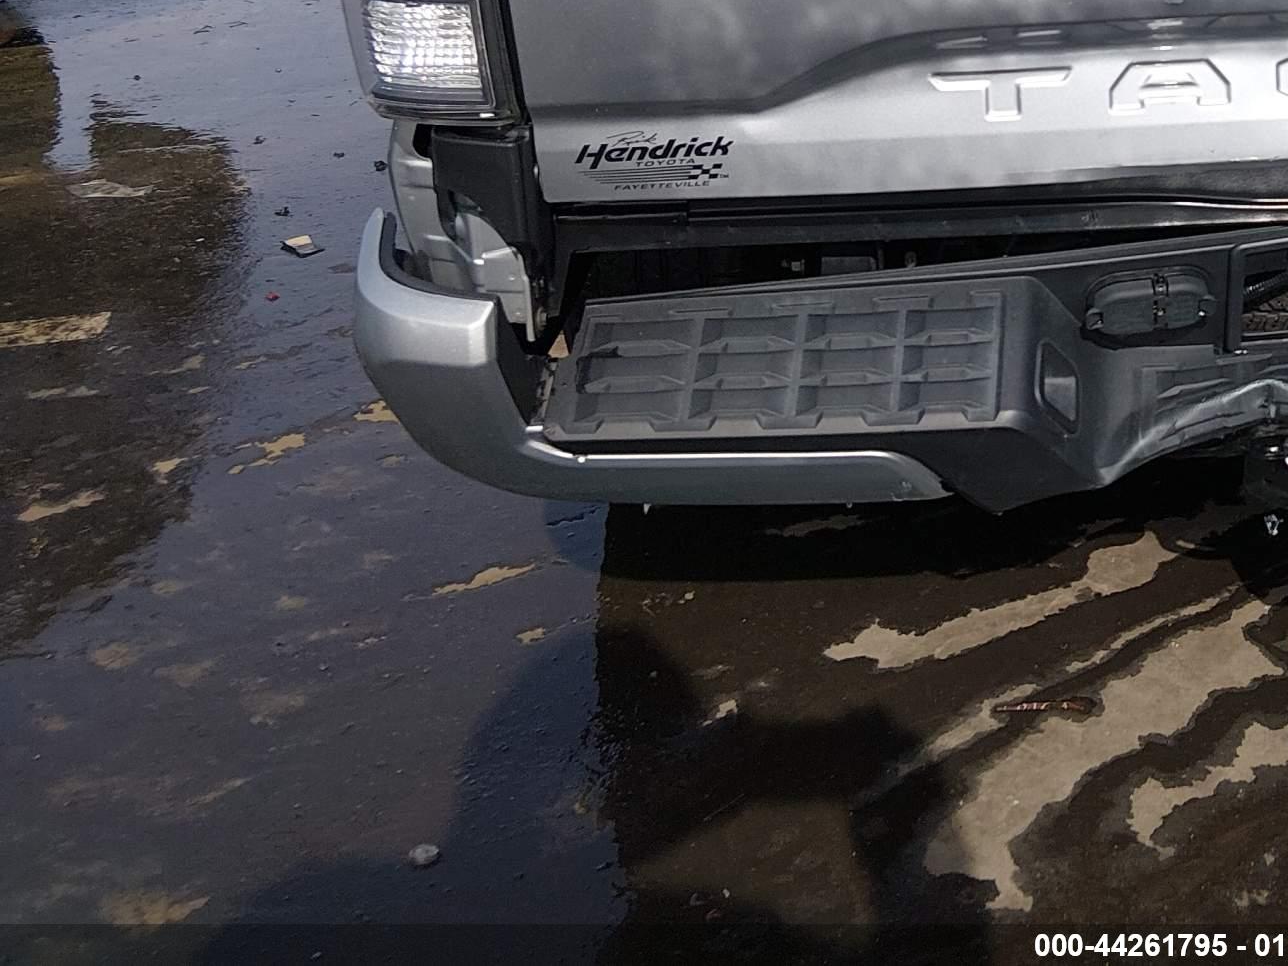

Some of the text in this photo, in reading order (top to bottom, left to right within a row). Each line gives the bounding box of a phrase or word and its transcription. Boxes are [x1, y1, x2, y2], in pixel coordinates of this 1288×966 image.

[574, 136, 734, 170] Hendrick
[636, 158, 695, 167] TOYOTA
[614, 180, 711, 191] FAYETTEVILLE
